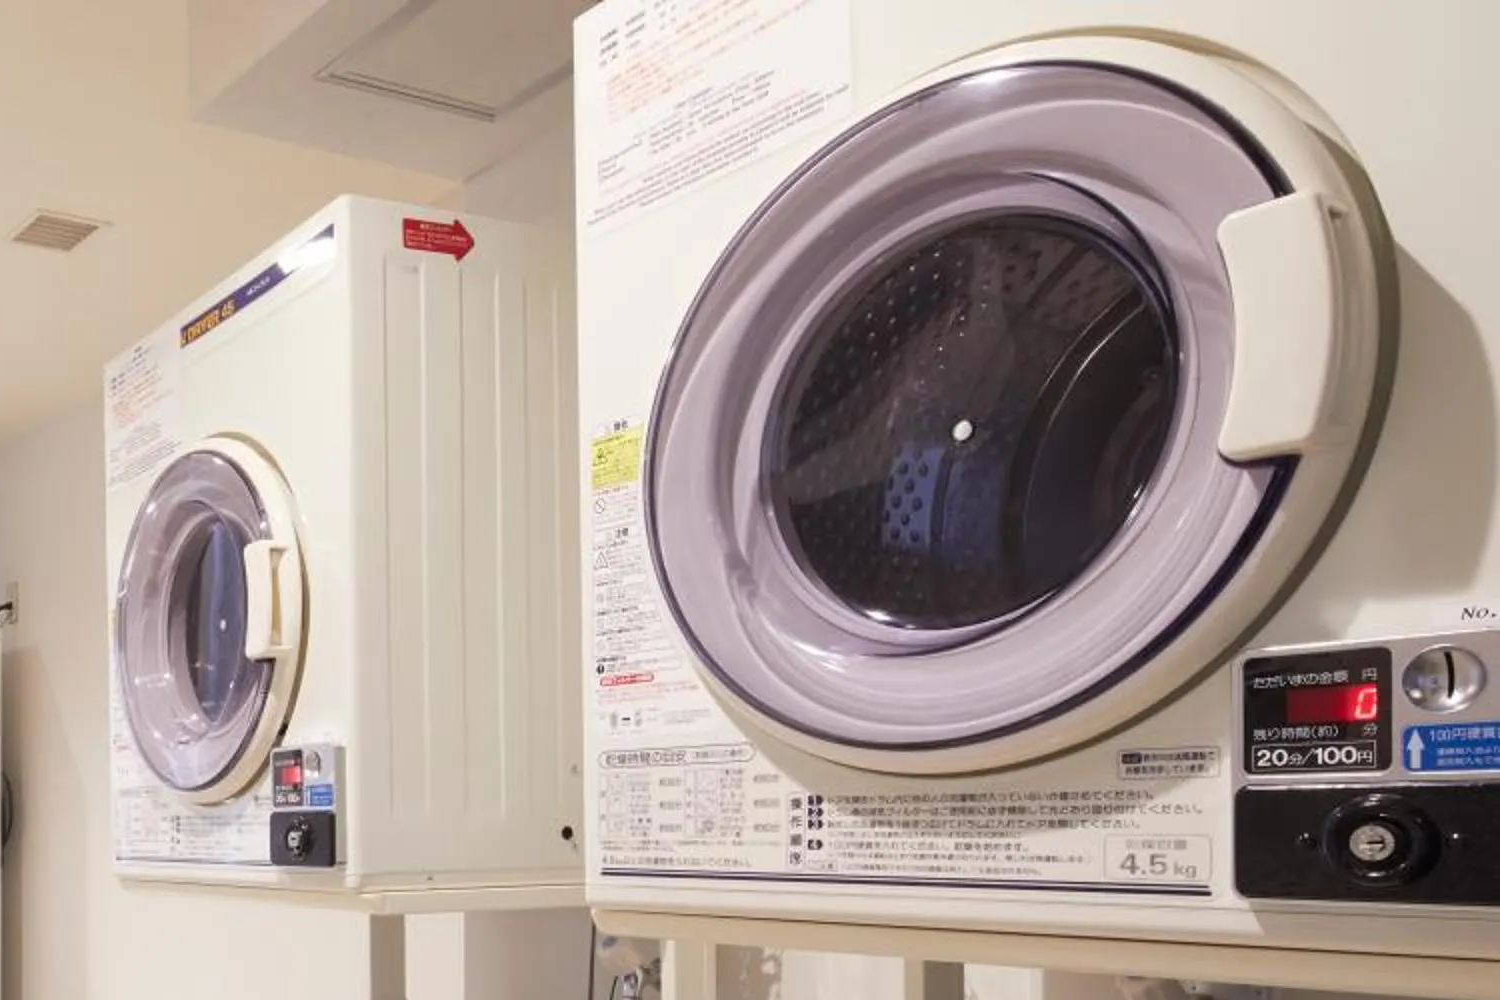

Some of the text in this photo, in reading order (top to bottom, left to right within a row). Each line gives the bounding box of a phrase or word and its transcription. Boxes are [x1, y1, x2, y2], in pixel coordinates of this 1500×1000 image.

[1361, 668, 1377, 680] 円
[1355, 688, 1377, 720] 0
[1256, 746, 1374, 767] 20分/100円
